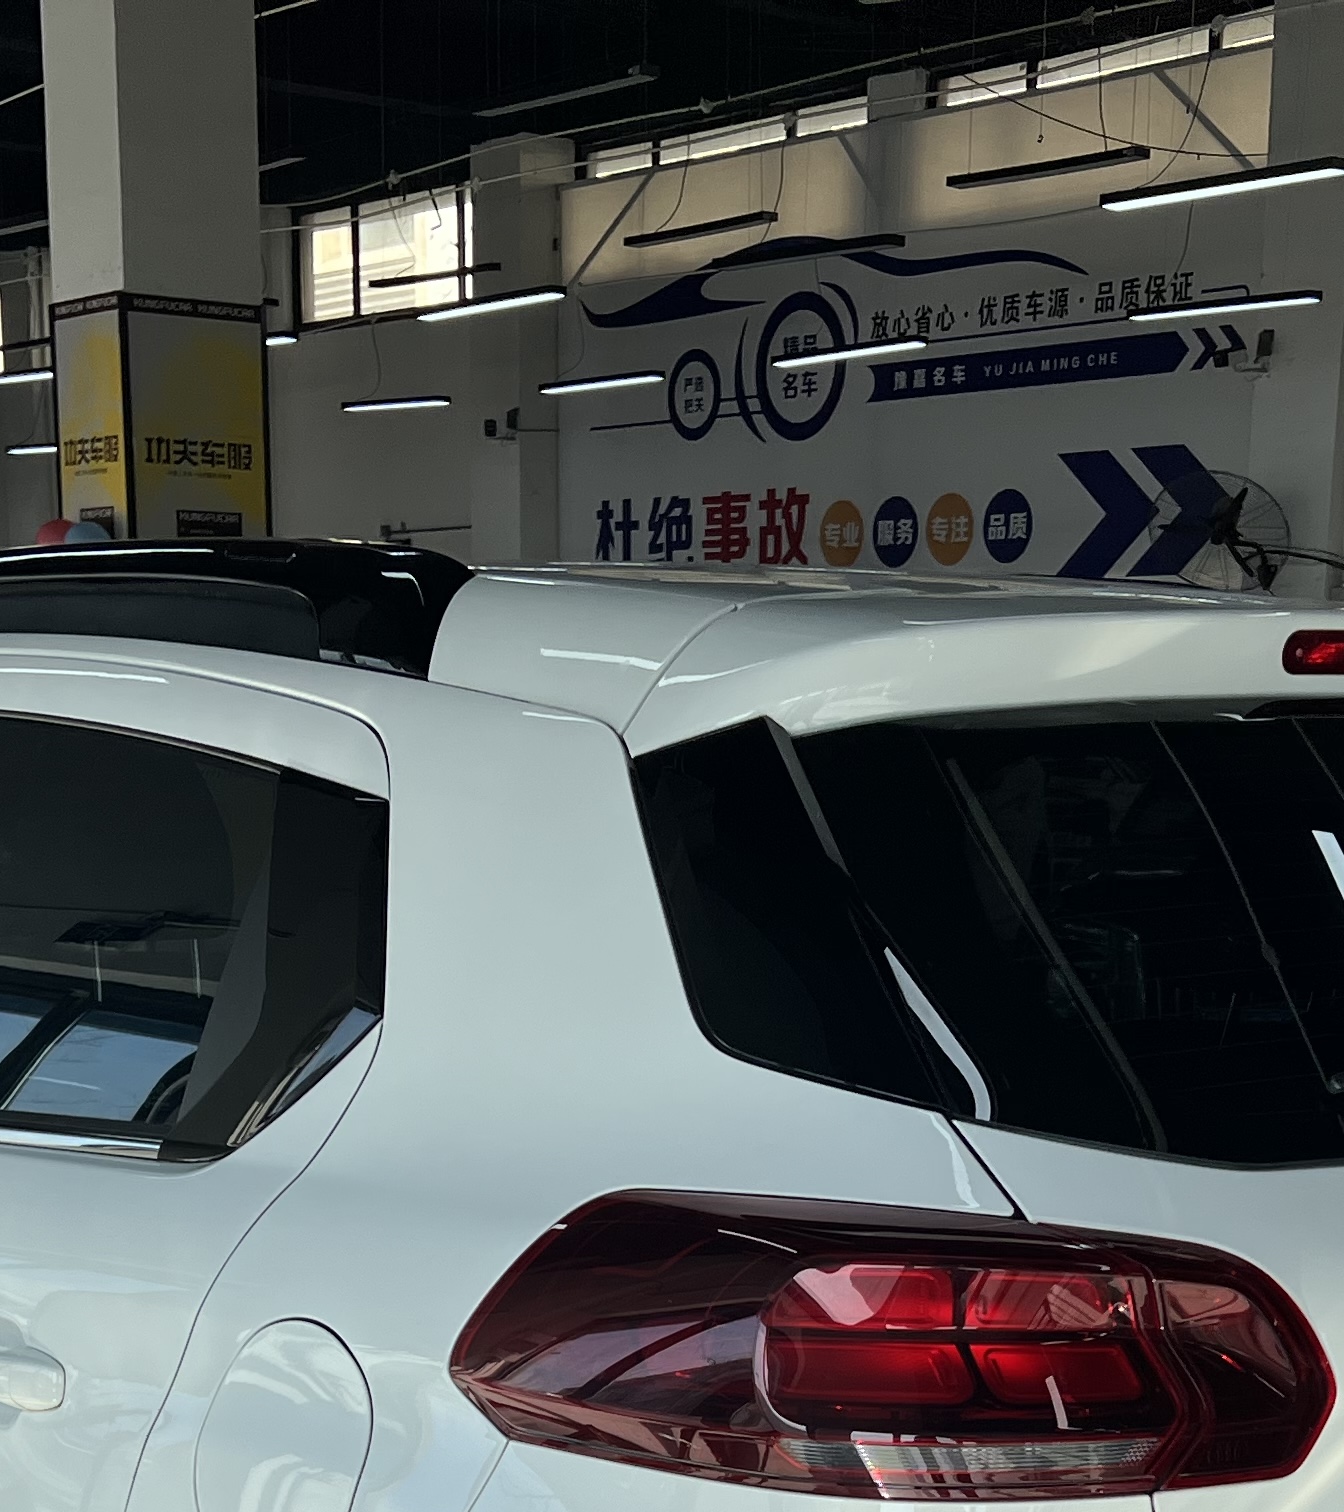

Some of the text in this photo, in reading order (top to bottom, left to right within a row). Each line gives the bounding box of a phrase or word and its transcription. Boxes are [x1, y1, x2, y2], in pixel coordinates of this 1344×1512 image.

[983, 364, 1003, 378] YU
[1009, 360, 1035, 375] JIA
[1042, 355, 1081, 372] MING
[1087, 351, 1119, 367] CHE
[782, 370, 818, 400] 名车
[64, 435, 119, 467] 功夫车服
[144, 436, 253, 471] 功夫车服
[595, 486, 811, 566] 杜绝事故
[823, 521, 860, 549] 专业
[876, 517, 915, 547] 服务
[930, 516, 970, 544] 专注
[987, 511, 1029, 542] 品质
